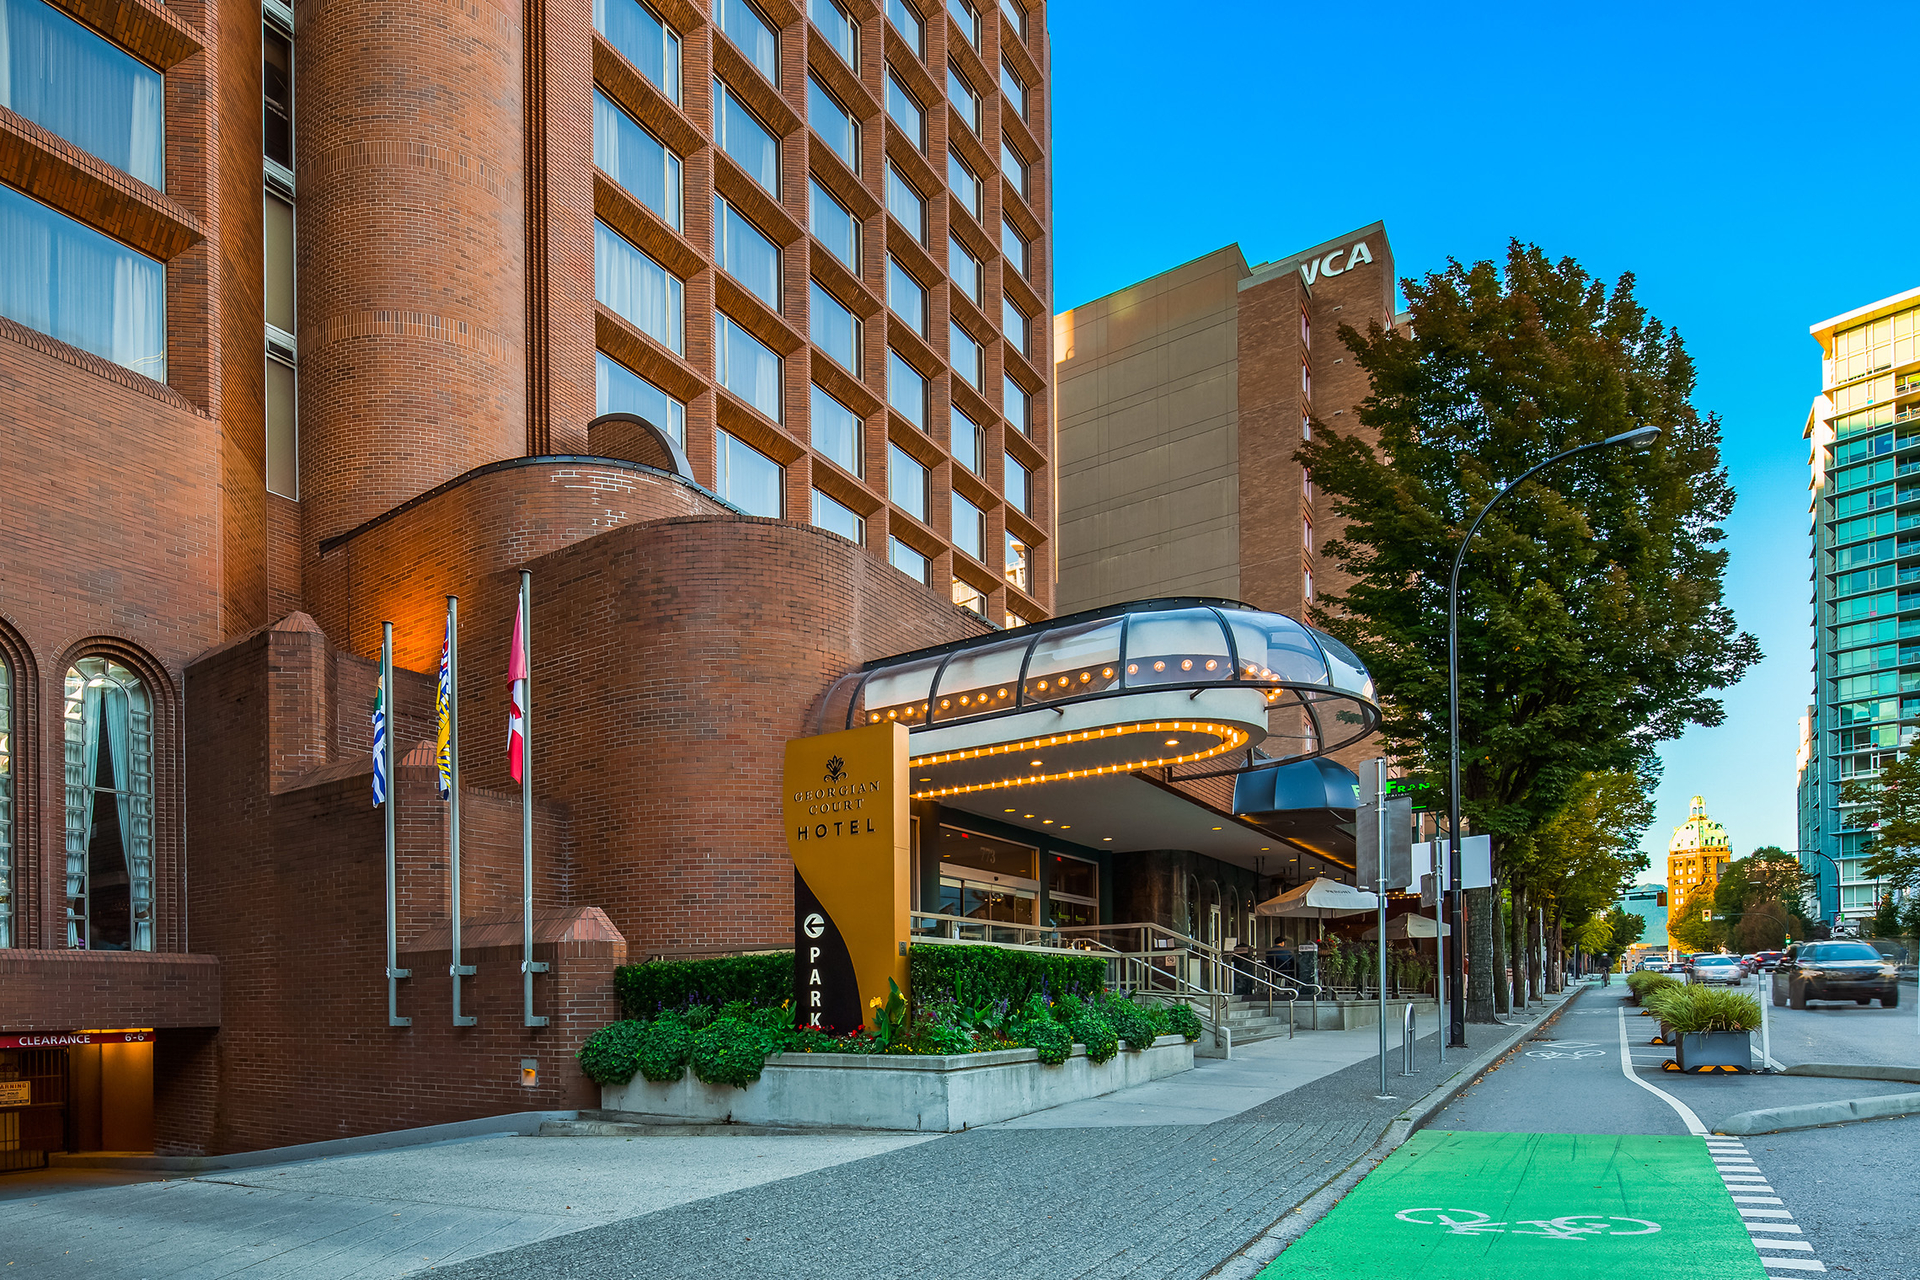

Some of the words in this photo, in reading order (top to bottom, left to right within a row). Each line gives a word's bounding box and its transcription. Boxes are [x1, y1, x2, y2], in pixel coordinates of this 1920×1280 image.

[794, 780, 880, 803] GEORGIAN
[809, 798, 865, 816] COURT
[798, 818, 876, 841] HOTEL
[980, 846, 996, 864] 773
[809, 946, 822, 1028] PARK
[18, 1034, 91, 1046] CLEARANCE
